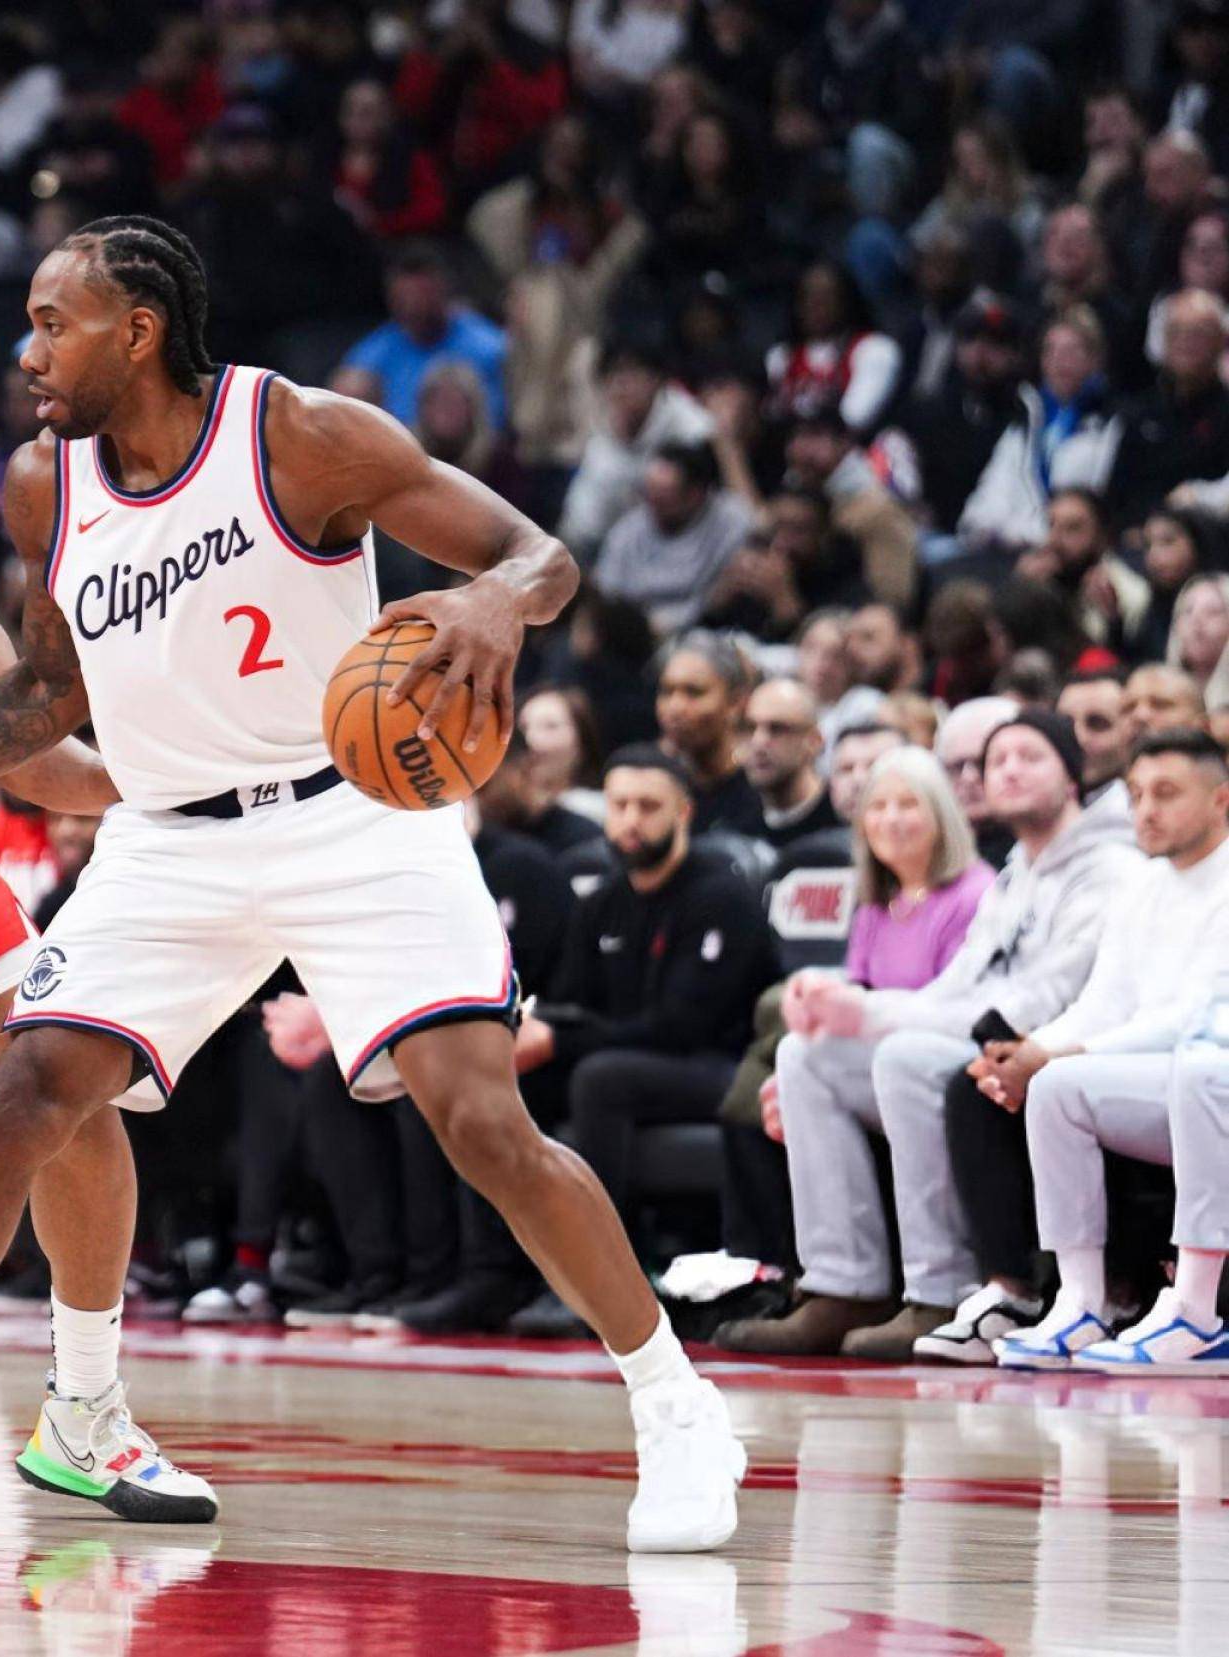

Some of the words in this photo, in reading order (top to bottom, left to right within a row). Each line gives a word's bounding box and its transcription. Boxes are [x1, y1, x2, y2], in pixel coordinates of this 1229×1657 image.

[75, 516, 255, 641] Clippers
[223, 605, 284, 678] 2
[393, 733, 451, 810] Wilso
